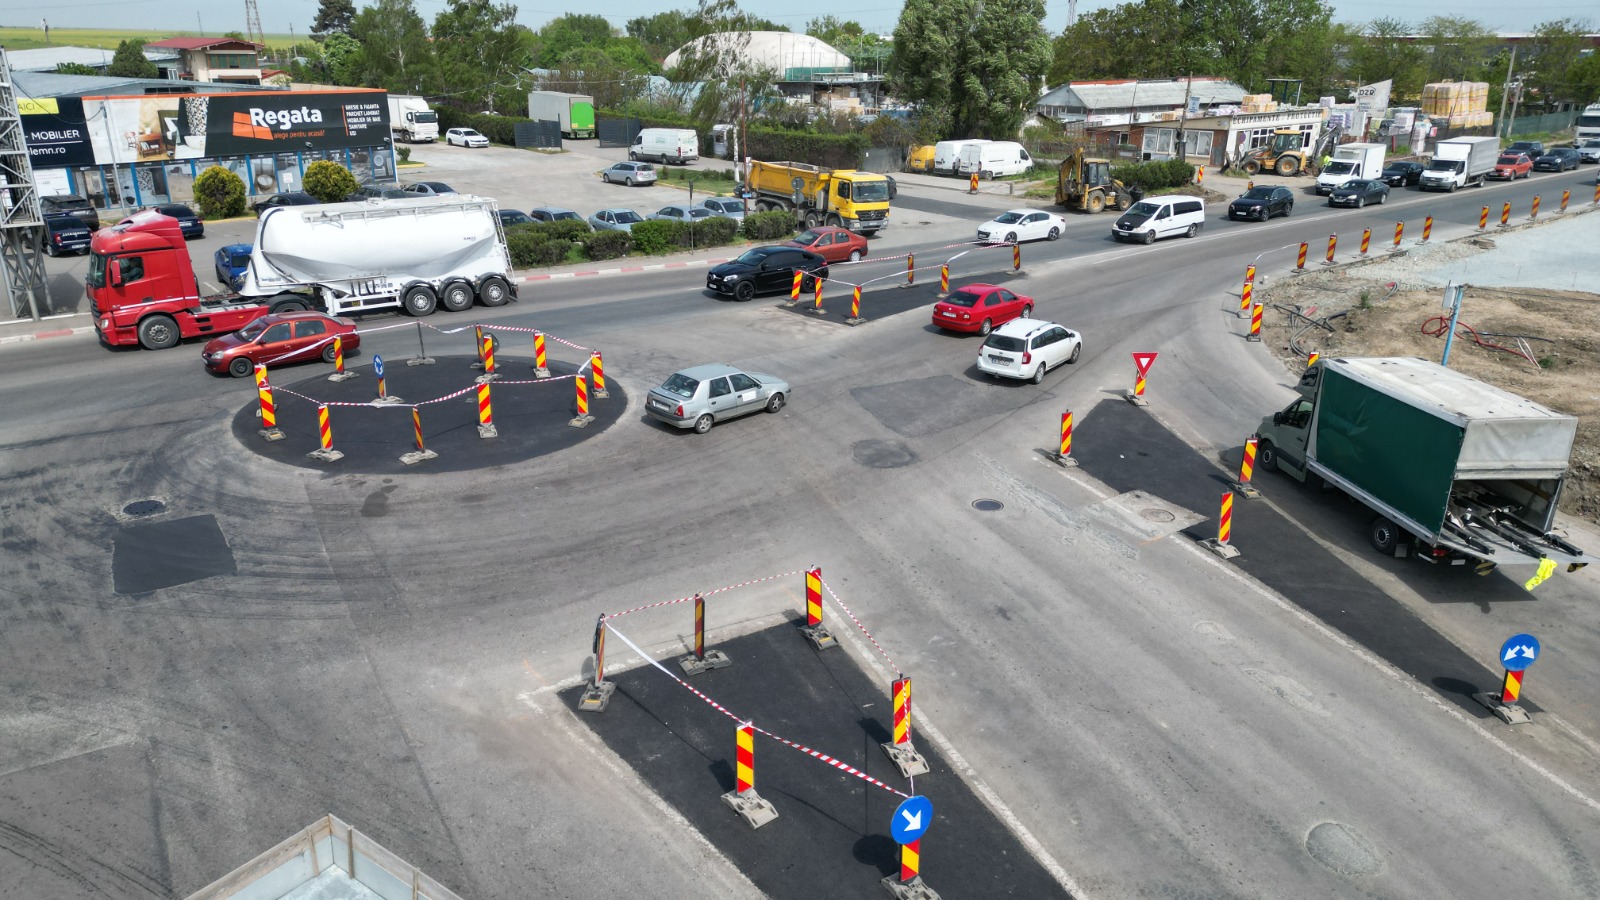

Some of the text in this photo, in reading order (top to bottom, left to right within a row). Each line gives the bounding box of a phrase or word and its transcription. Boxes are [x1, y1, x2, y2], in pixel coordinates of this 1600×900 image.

[249, 106, 323, 130] Regata
[1232, 114, 1280, 125] ECHIPAMENTE
[31, 129, 80, 140] MOBILIER
[289, 131, 307, 139] pentru
[28, 147, 66, 156] lemn.ro
